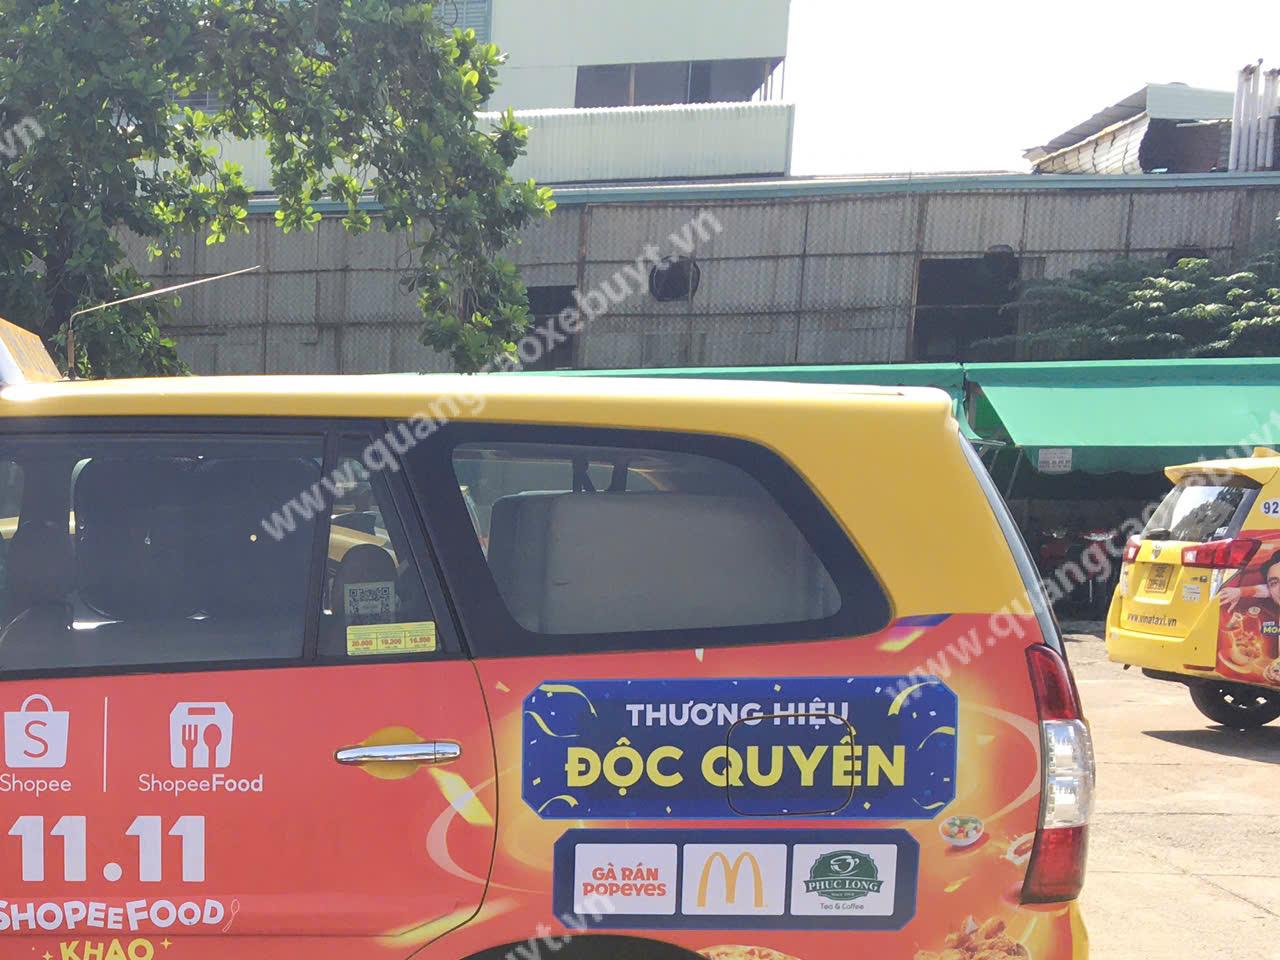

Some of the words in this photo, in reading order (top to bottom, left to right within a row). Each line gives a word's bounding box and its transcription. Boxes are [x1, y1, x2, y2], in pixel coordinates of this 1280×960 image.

[625, 698, 764, 728] THƯƠNG
[773, 696, 849, 731] HIỆU
[565, 735, 685, 797] ĐỘC
[700, 725, 906, 788] QUYỀN
[0, 773, 72, 797] Shopee
[138, 773, 264, 797] ShopeeFood
[7, 814, 206, 883] 11.11
[591, 862, 619, 881] GÀ
[622, 861, 659, 881] RÁN
[809, 879, 842, 891] PHUC
[845, 879, 878, 891] LONG
[820, 902, 833, 911] Tea
[842, 902, 865, 911] Coffee
